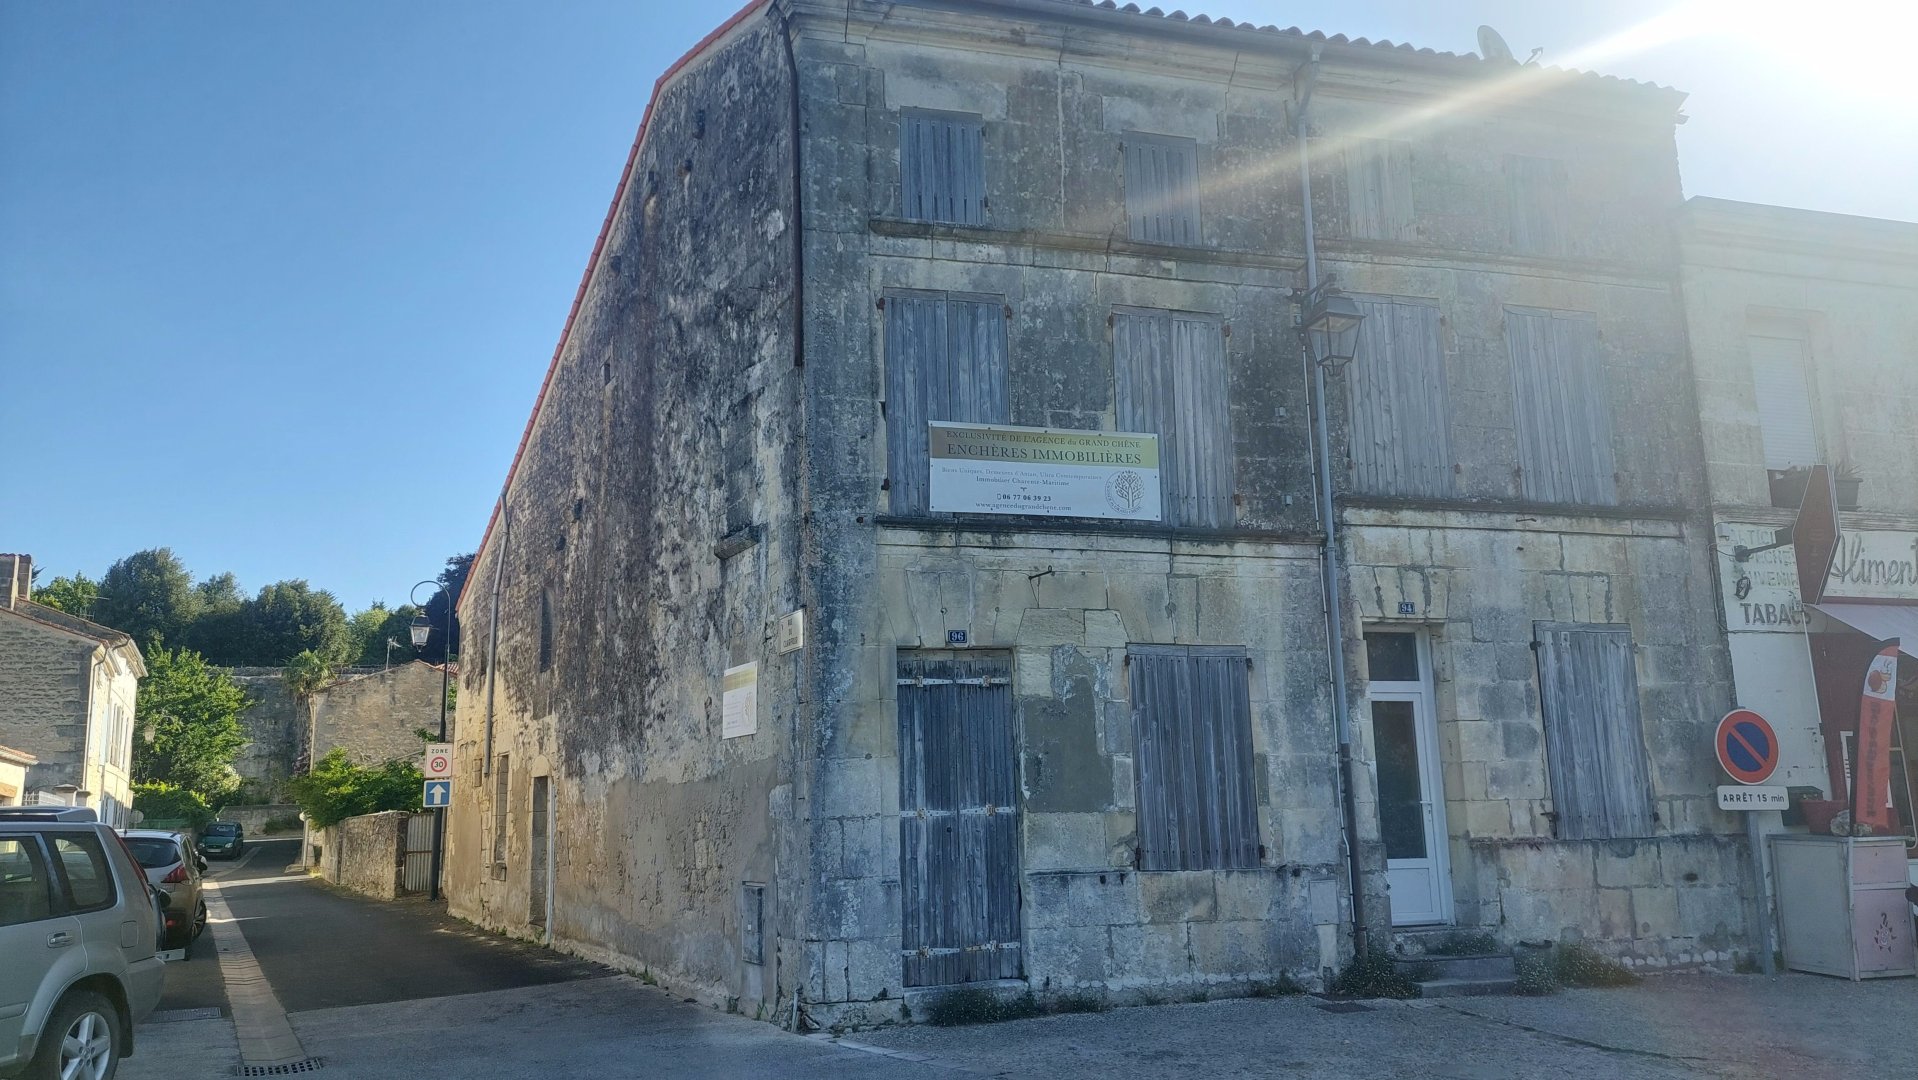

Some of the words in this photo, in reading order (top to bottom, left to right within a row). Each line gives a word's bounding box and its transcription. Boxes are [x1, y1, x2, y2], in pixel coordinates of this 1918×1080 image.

[946, 430, 1007, 442] EXCLUSIVITÉ
[1009, 434, 1022, 443] DE
[1023, 434, 1065, 445] L'AGENCE
[1078, 438, 1110, 447] GRAND
[1111, 439, 1141, 448] CHÊNE
[947, 443, 1028, 459] ENCHÈRES
[1032, 448, 1142, 464] IMMOBILIÈRES
[976, 475, 1010, 483] Immobilier
[1011, 477, 1070, 486] Charente-Maritime
[952, 632, 963, 641] 96
[1723, 791, 1753, 803] ARRÊT
[1756, 795, 1768, 803] 15
[1770, 794, 1785, 803] min
